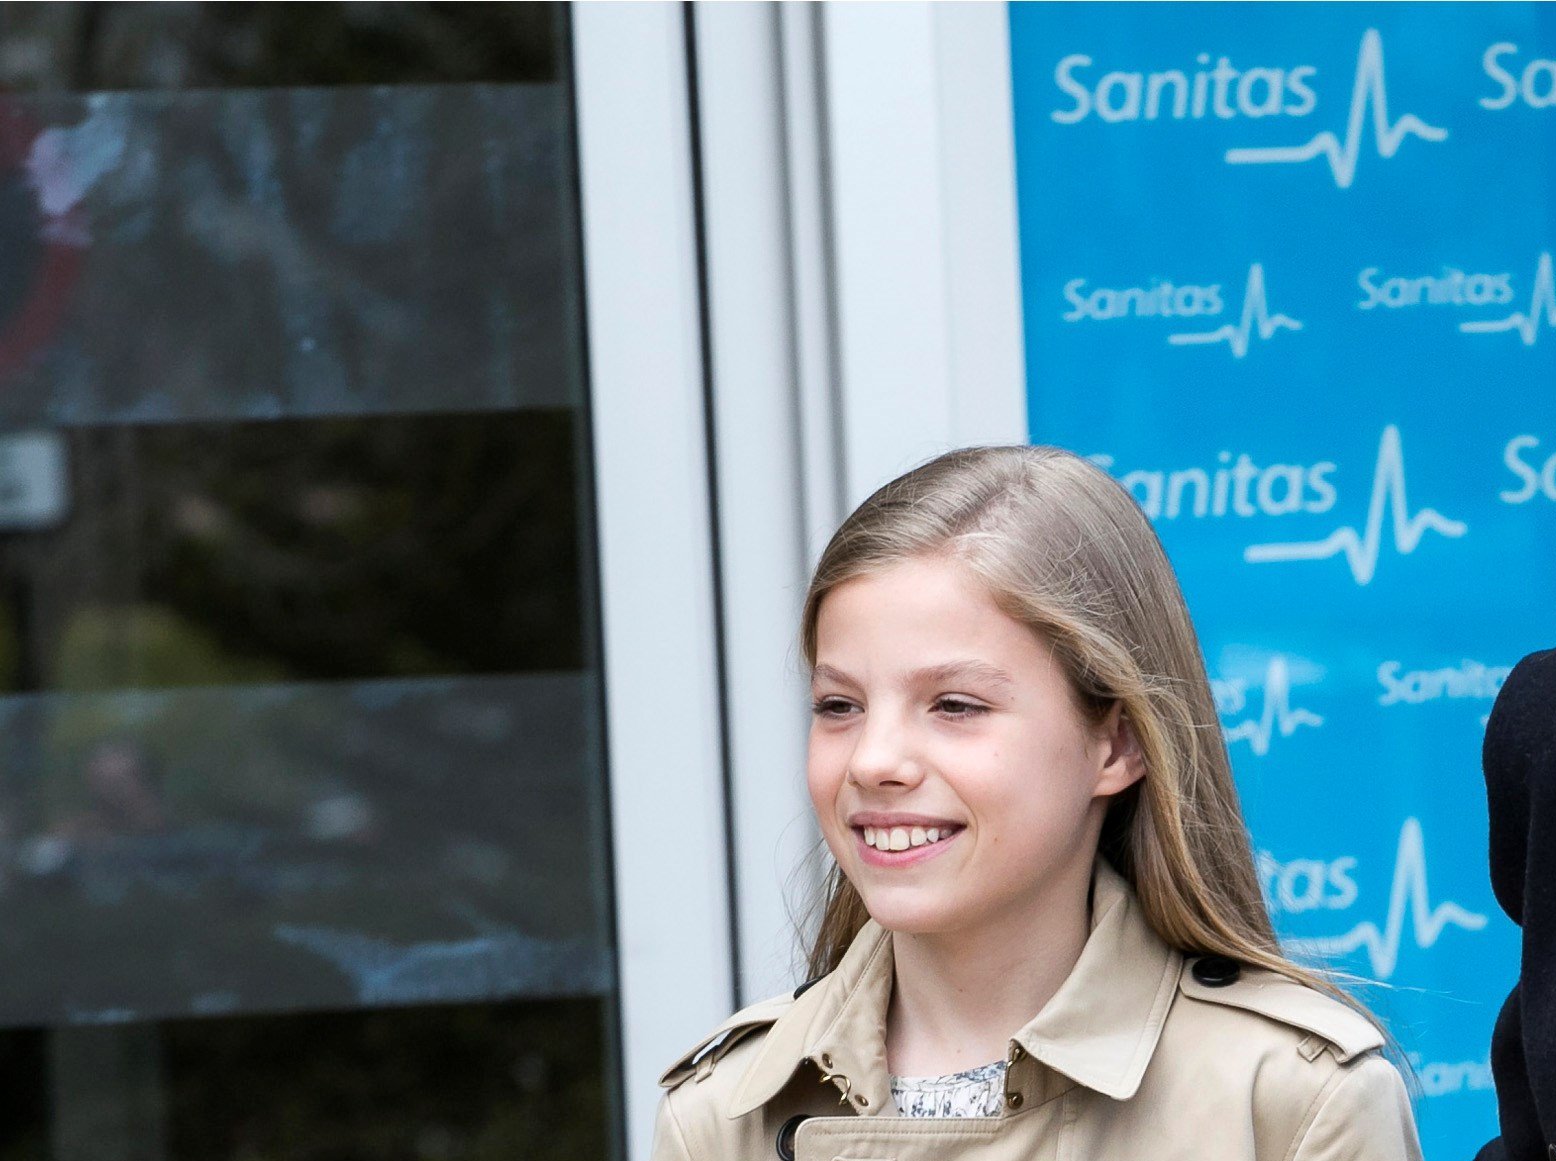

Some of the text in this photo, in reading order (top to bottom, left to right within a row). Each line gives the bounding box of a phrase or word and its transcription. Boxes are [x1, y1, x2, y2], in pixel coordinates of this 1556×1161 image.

[1051, 52, 1317, 124] Sanitas
[1063, 277, 1223, 322] Sanitas
[1357, 266, 1513, 310] Sanitas
[1085, 450, 1337, 520] anitas
